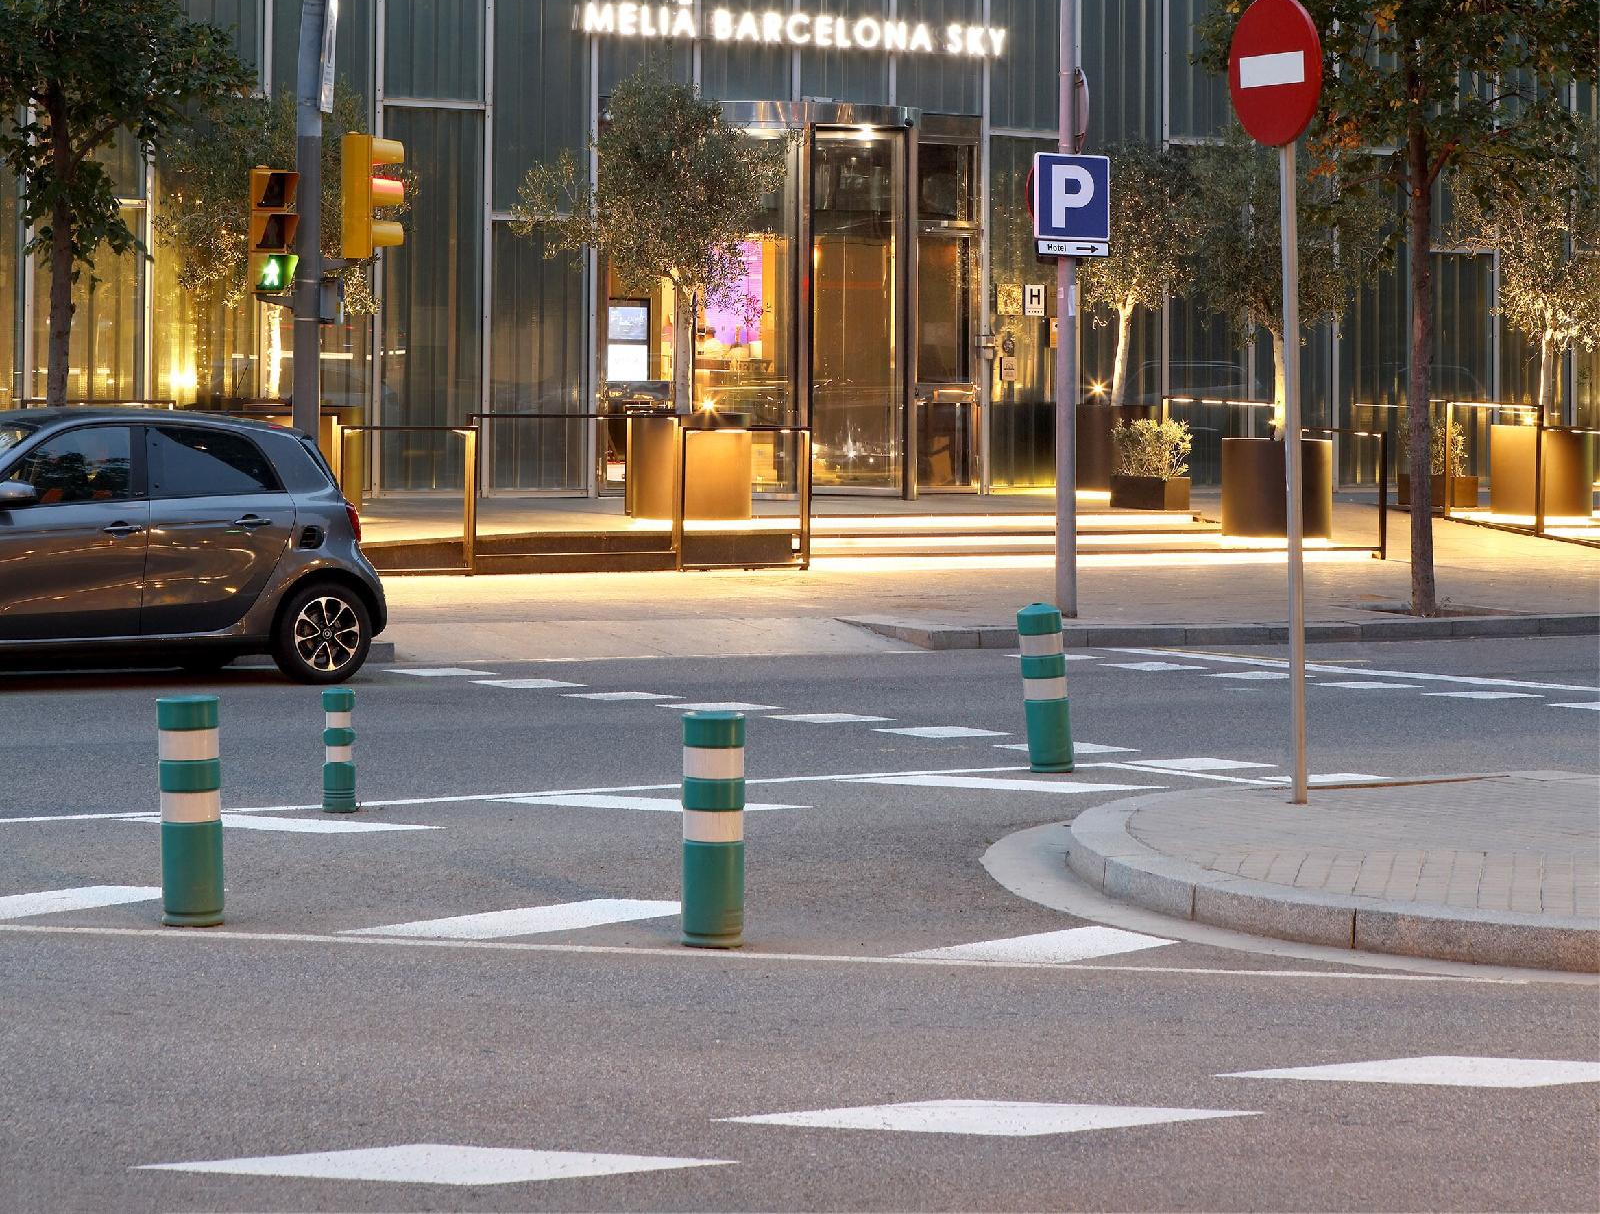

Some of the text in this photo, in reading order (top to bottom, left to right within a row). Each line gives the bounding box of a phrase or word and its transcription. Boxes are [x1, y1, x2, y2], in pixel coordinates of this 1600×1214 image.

[711, 8, 933, 52] BARCELONA
[946, 23, 1006, 56] SKY
[1052, 165, 1095, 229] P
[1047, 243, 1067, 252] Hotel
[1030, 288, 1041, 305] H
